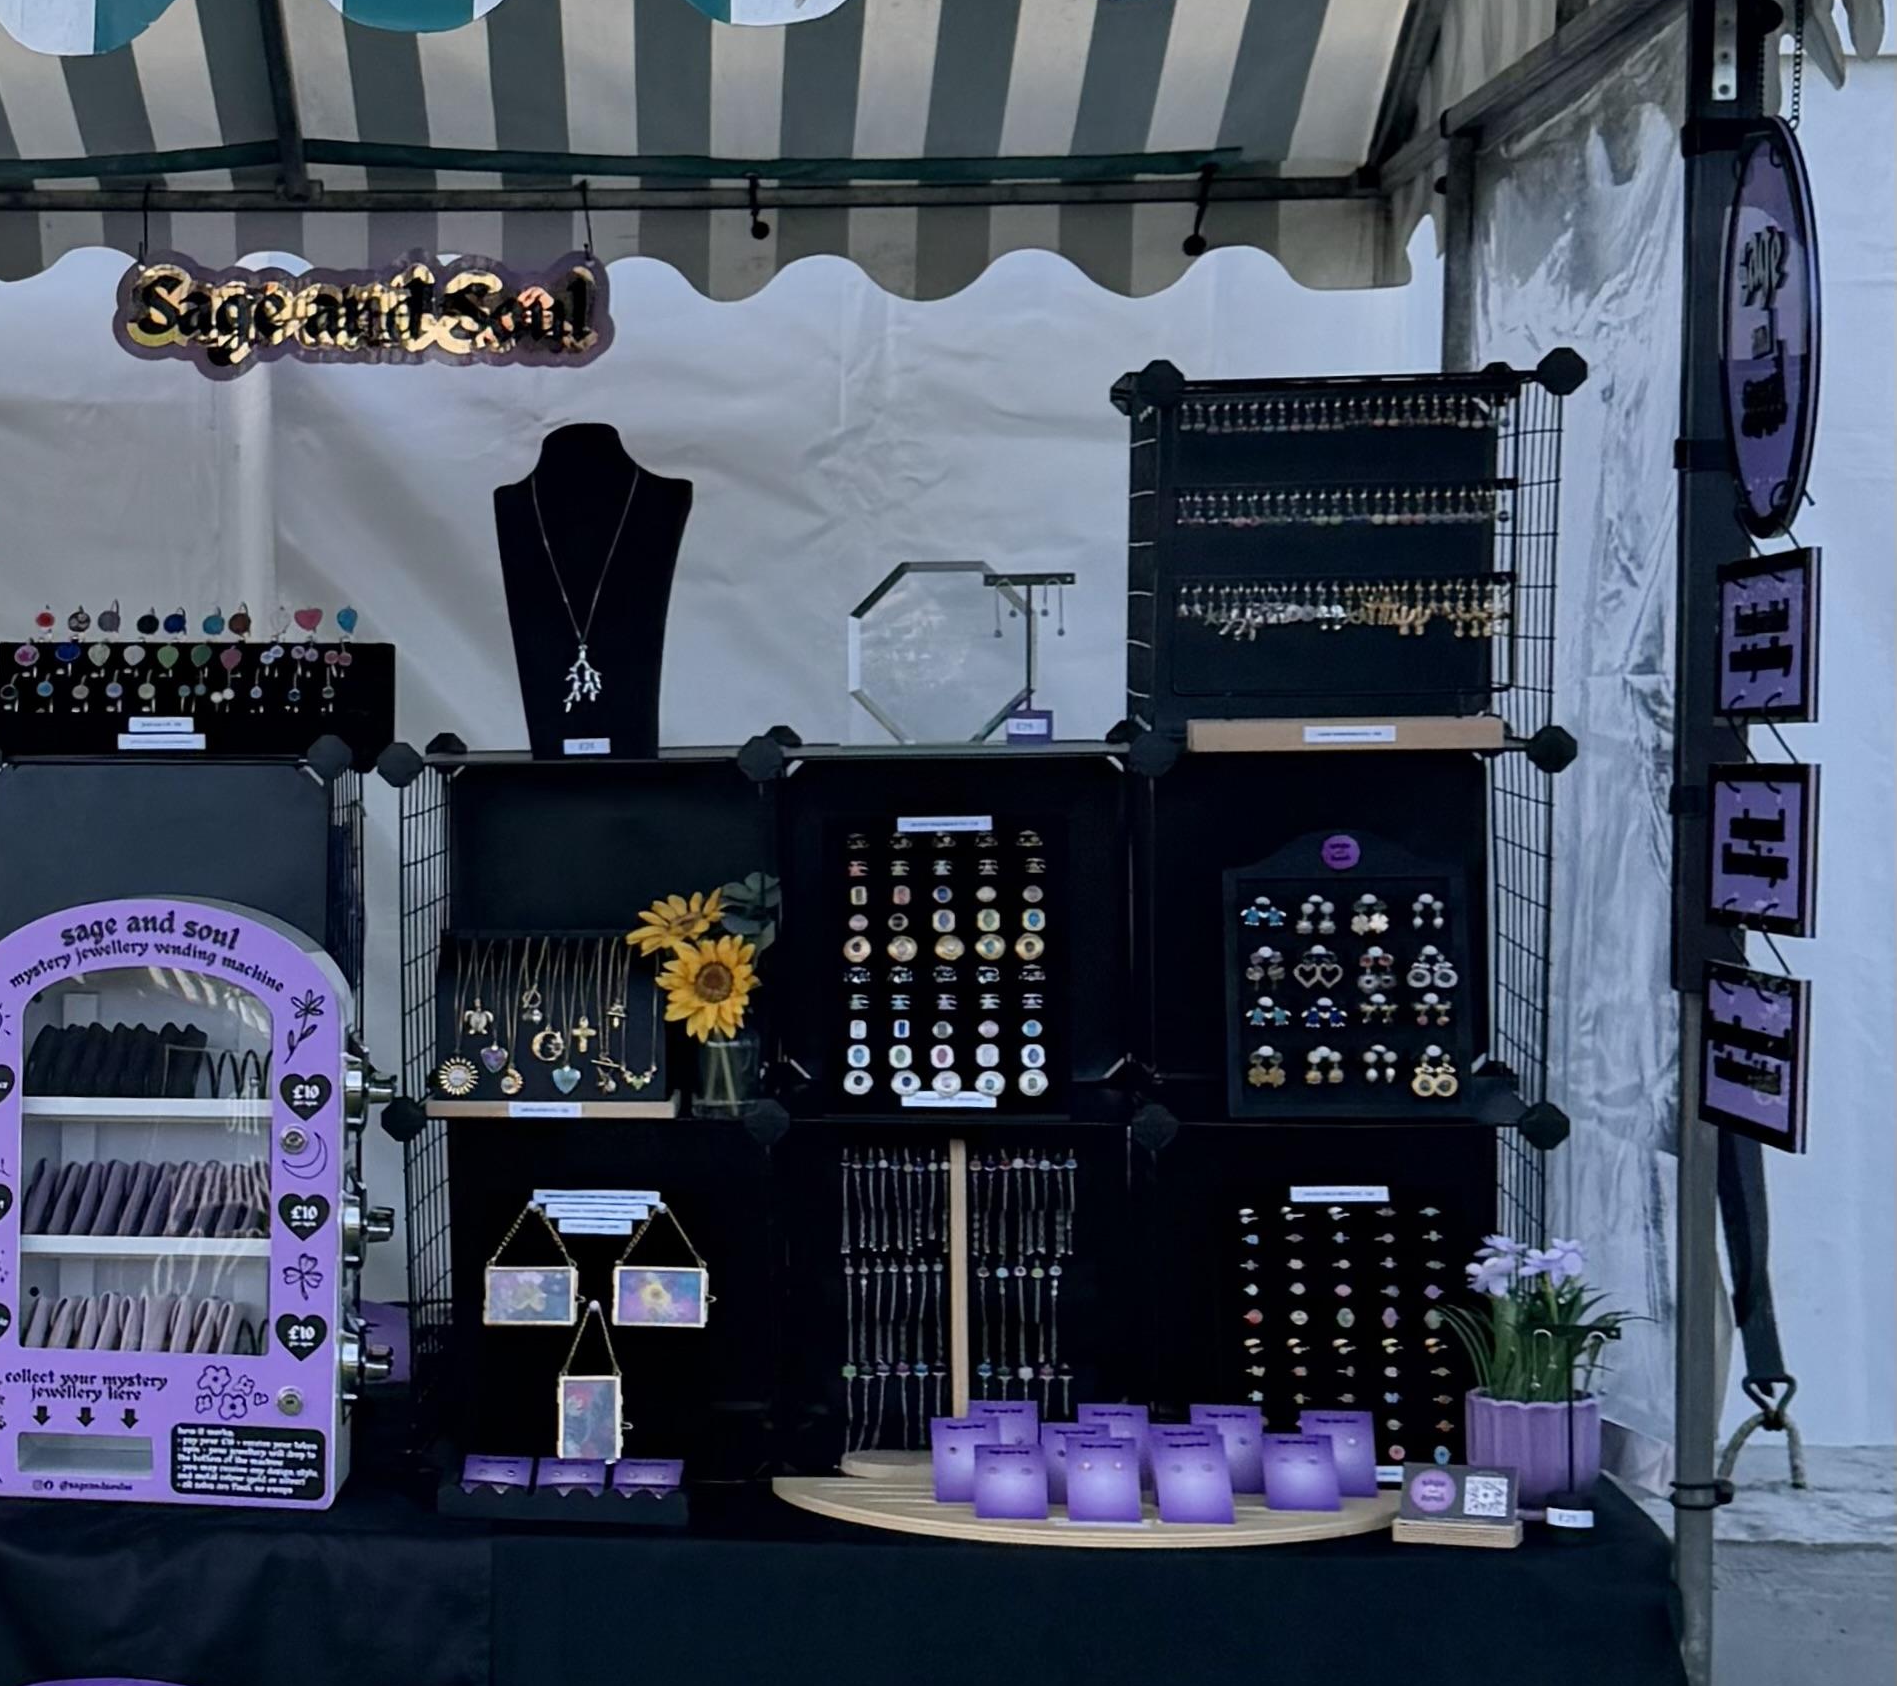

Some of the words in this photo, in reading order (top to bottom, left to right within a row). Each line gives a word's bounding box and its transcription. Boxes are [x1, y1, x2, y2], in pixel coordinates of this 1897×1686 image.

[127, 263, 295, 366] Sage
[298, 263, 433, 352] and
[432, 266, 597, 354] Soul
[60, 916, 117, 948] sage
[126, 910, 175, 934] and
[182, 916, 240, 950] soul
[9, 952, 72, 988] mystery
[75, 938, 148, 965] jewellery
[154, 940, 216, 967] vending
[221, 954, 284, 993] machine
[292, 1084, 320, 1099] £10
[290, 1205, 319, 1220] £10
[287, 1325, 316, 1340] £10
[5, 1368, 55, 1384] collect
[60, 1373, 97, 1386] your
[102, 1373, 168, 1392] mystery
[30, 1384, 103, 1404] jewellery
[108, 1385, 142, 1401] here
